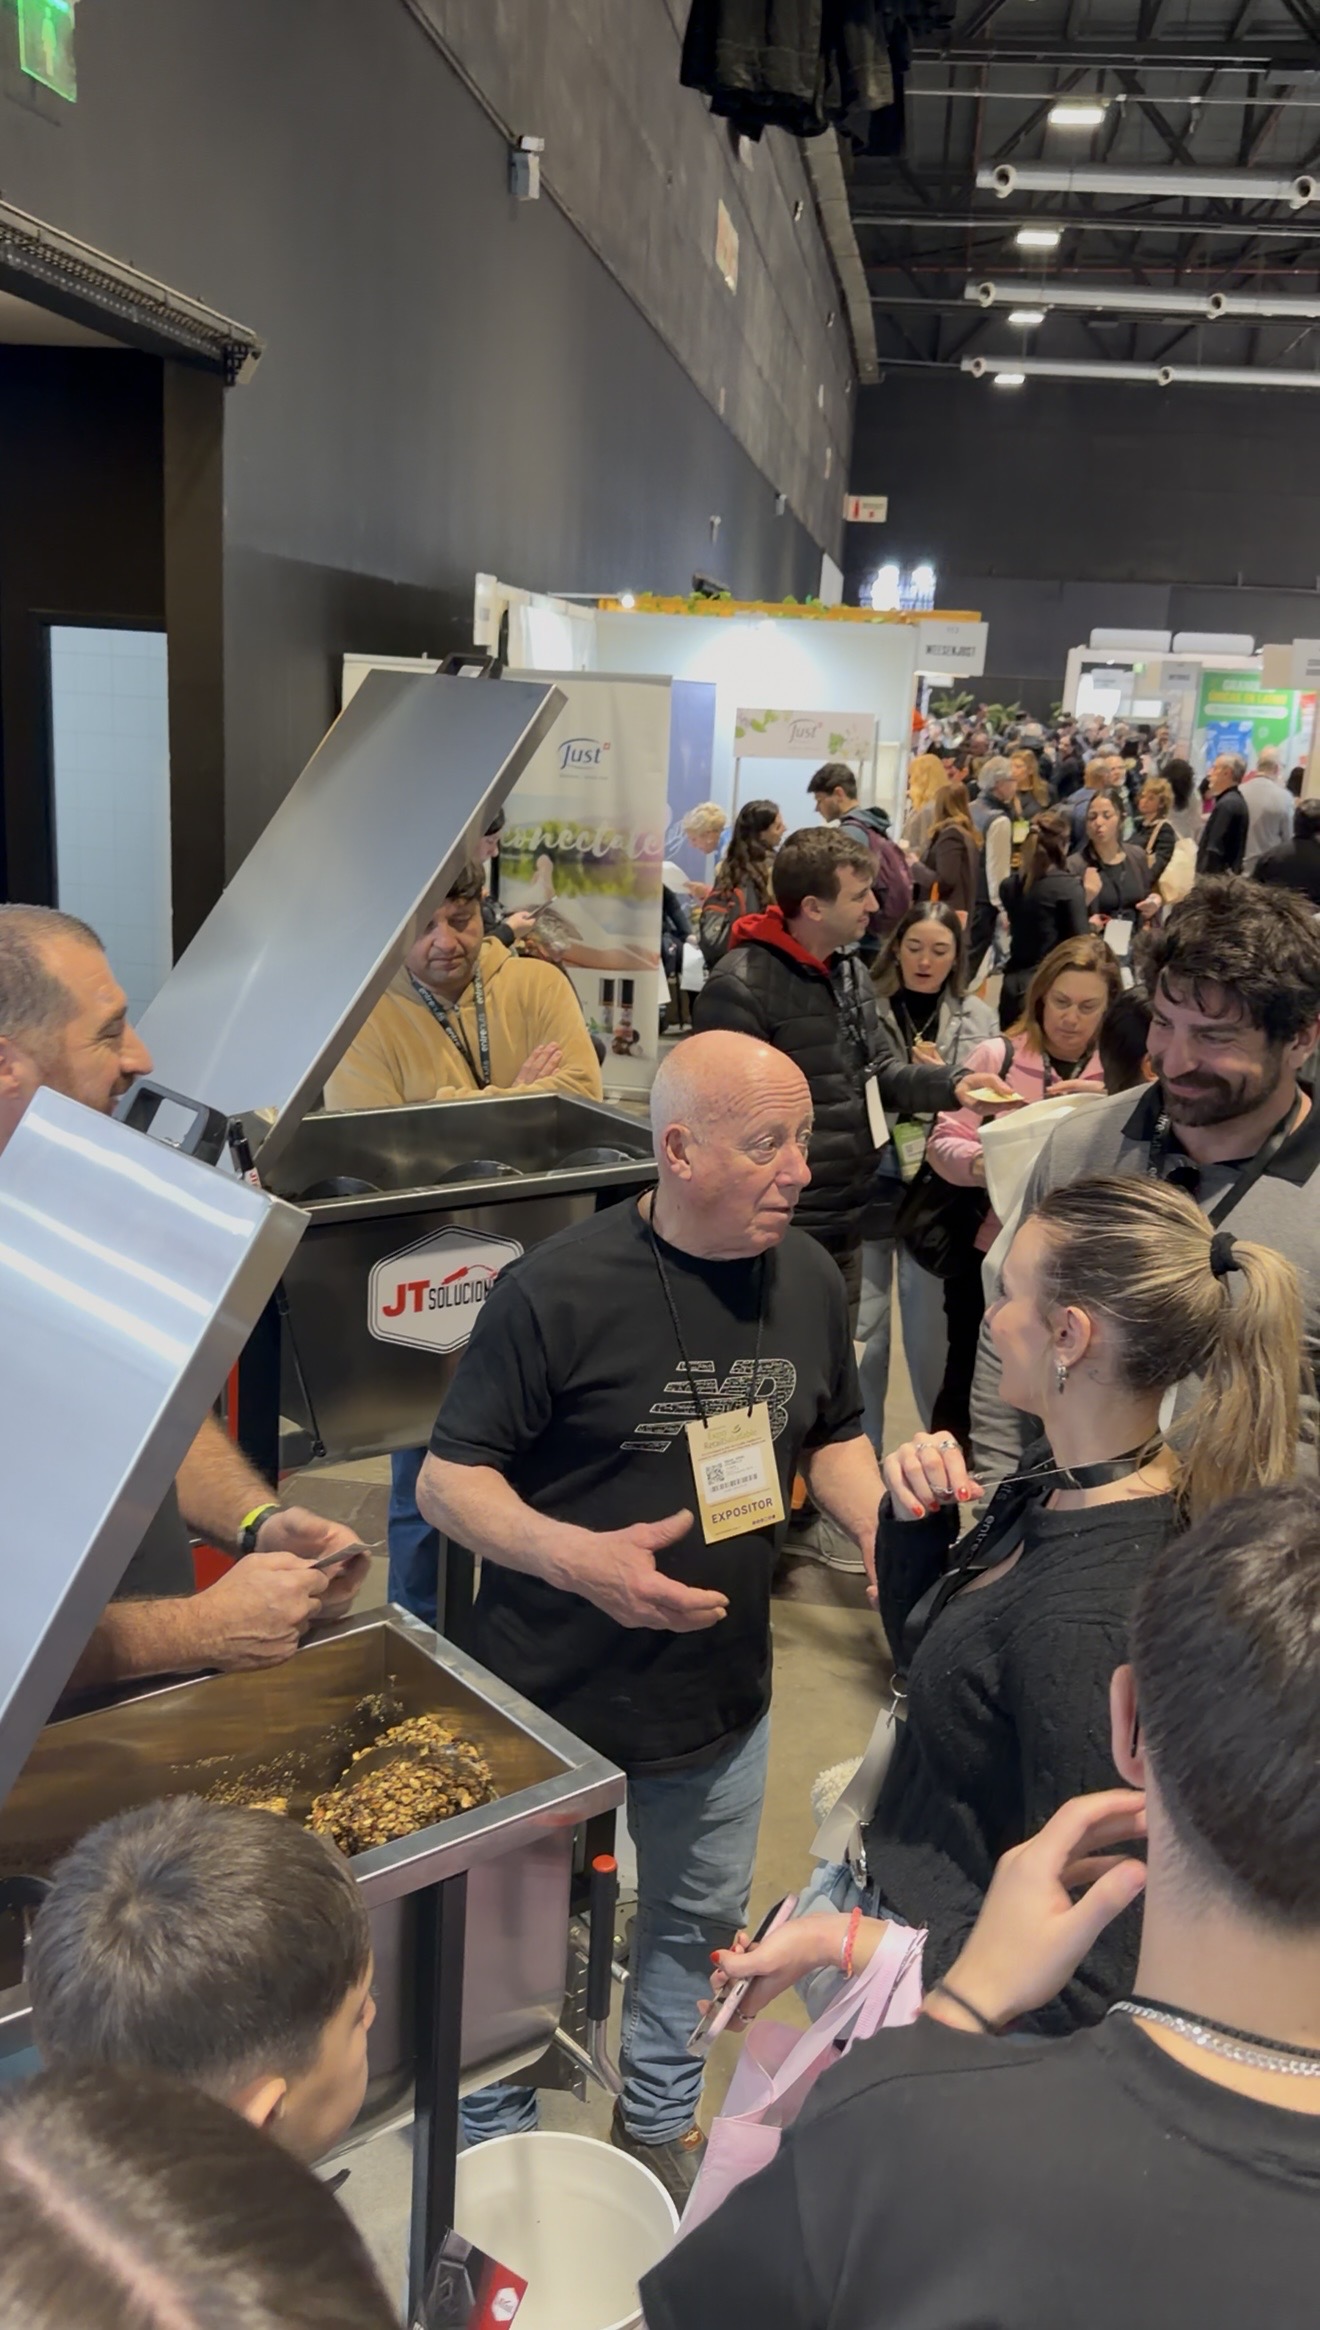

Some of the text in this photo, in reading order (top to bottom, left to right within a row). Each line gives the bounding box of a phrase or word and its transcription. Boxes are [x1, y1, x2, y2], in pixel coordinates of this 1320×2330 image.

[560, 743, 602, 770] Just
[382, 1279, 431, 1318] JT
[711, 1497, 774, 1524] EXPOSITOR
